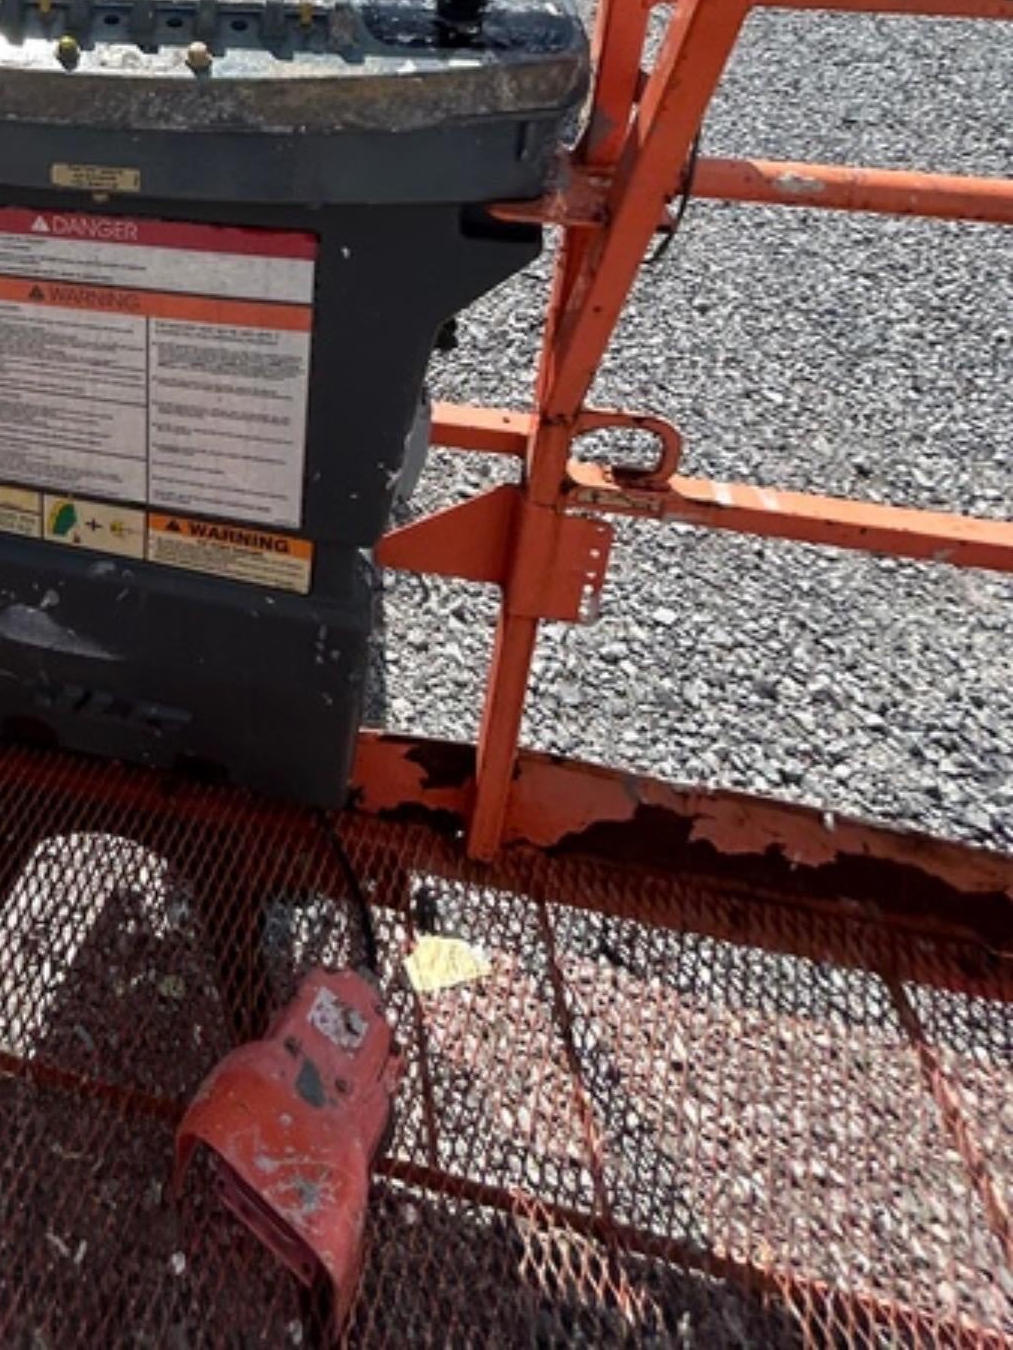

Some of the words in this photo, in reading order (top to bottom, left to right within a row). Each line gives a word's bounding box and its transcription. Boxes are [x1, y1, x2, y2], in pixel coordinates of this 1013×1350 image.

[52, 215, 139, 241] DANGER
[50, 286, 141, 311] WARNING
[188, 522, 291, 554] WARNING
